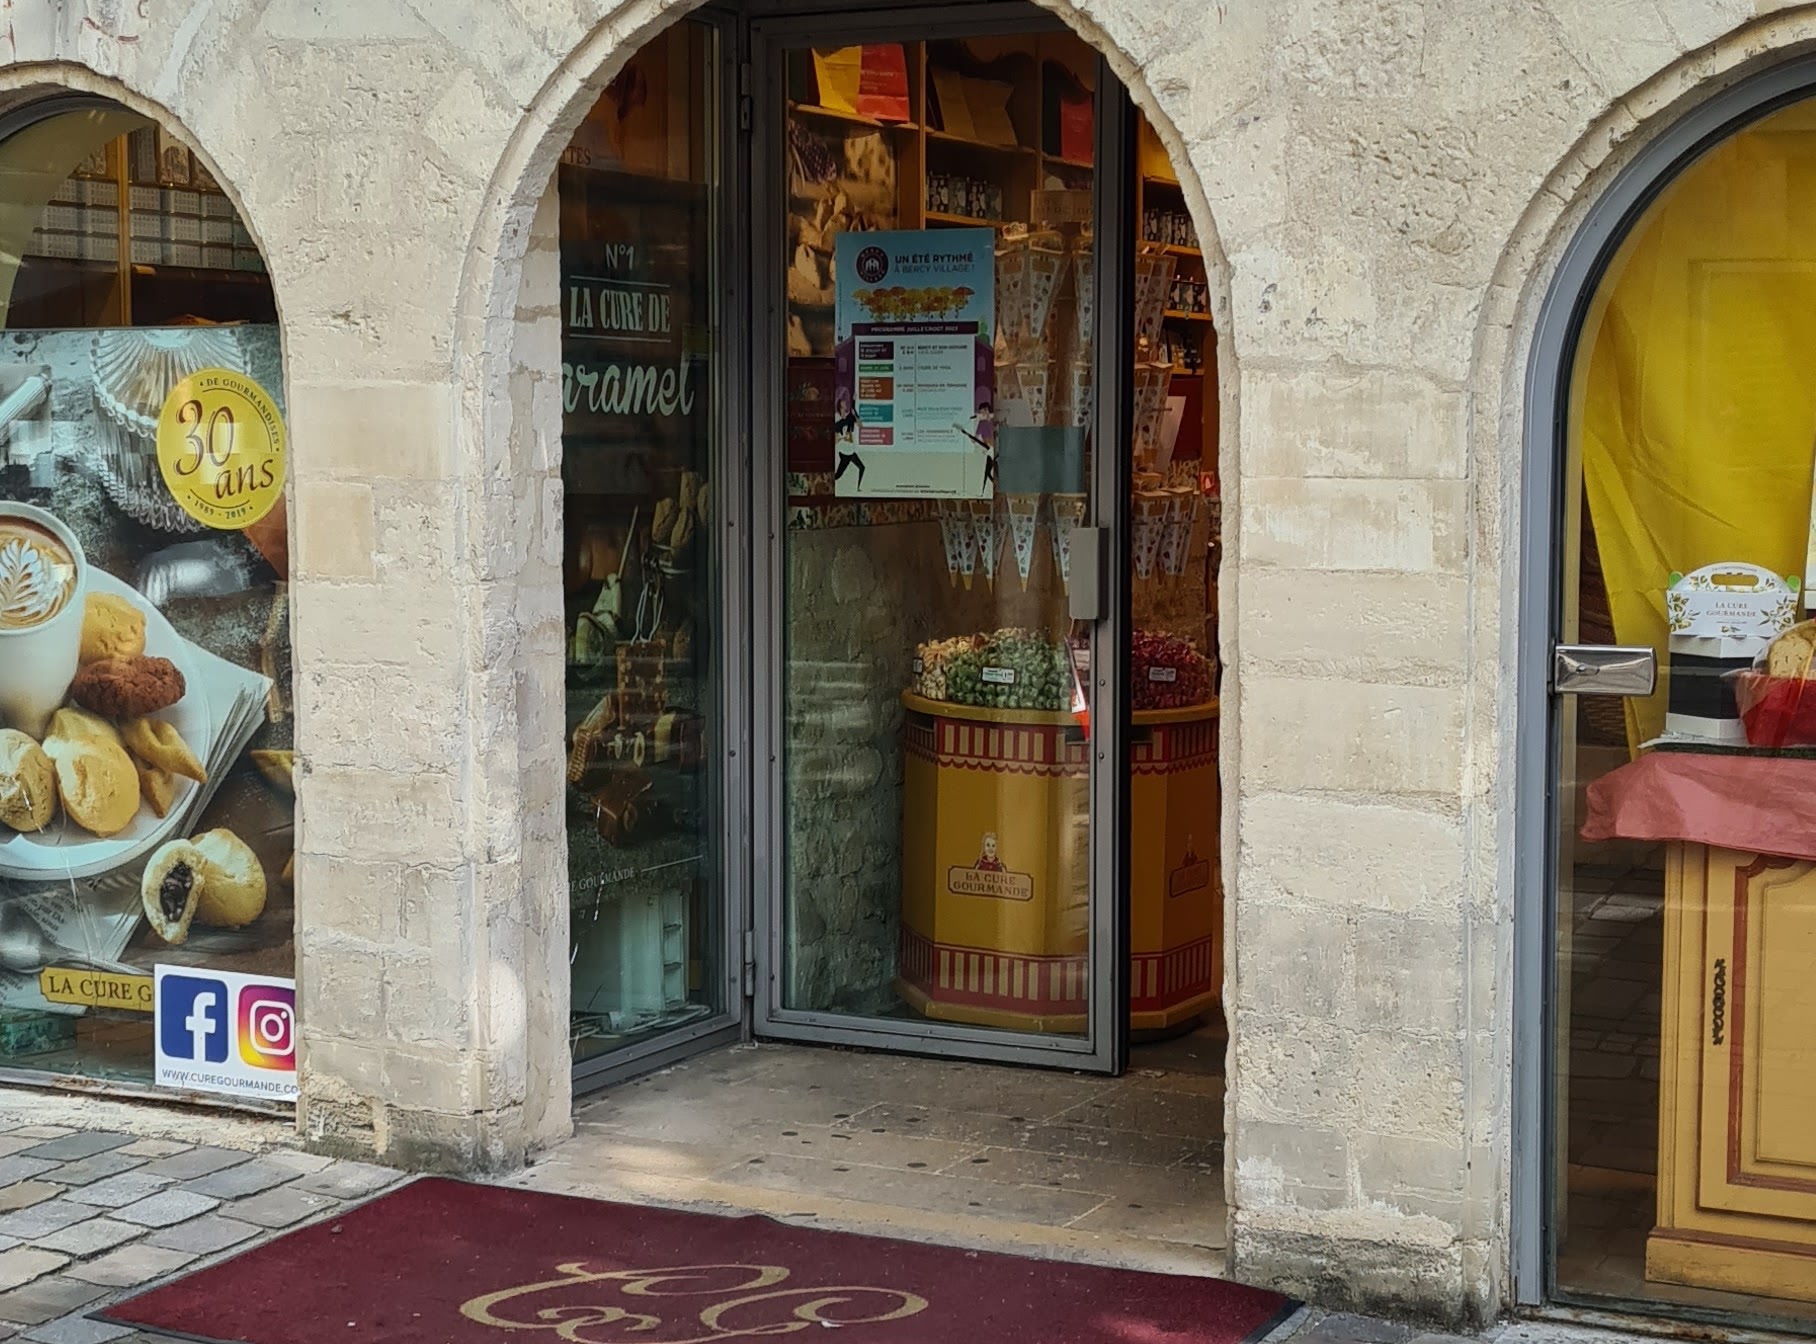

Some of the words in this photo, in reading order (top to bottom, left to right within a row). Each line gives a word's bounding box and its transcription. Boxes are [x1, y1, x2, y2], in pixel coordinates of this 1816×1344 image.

[895, 255, 909, 264] UN
[570, 286, 592, 329] LA
[600, 289, 643, 332] CURE
[648, 293, 671, 334] DE
[206, 377, 220, 386] DE
[222, 378, 280, 445] GOURMANDISES
[173, 399, 234, 476] 30
[215, 459, 275, 500] ans
[225, 507, 247, 519] 2019
[953, 881, 1029, 897] GOURMANDE
[48, 976, 74, 994] LA
[80, 978, 132, 1000] CURE
